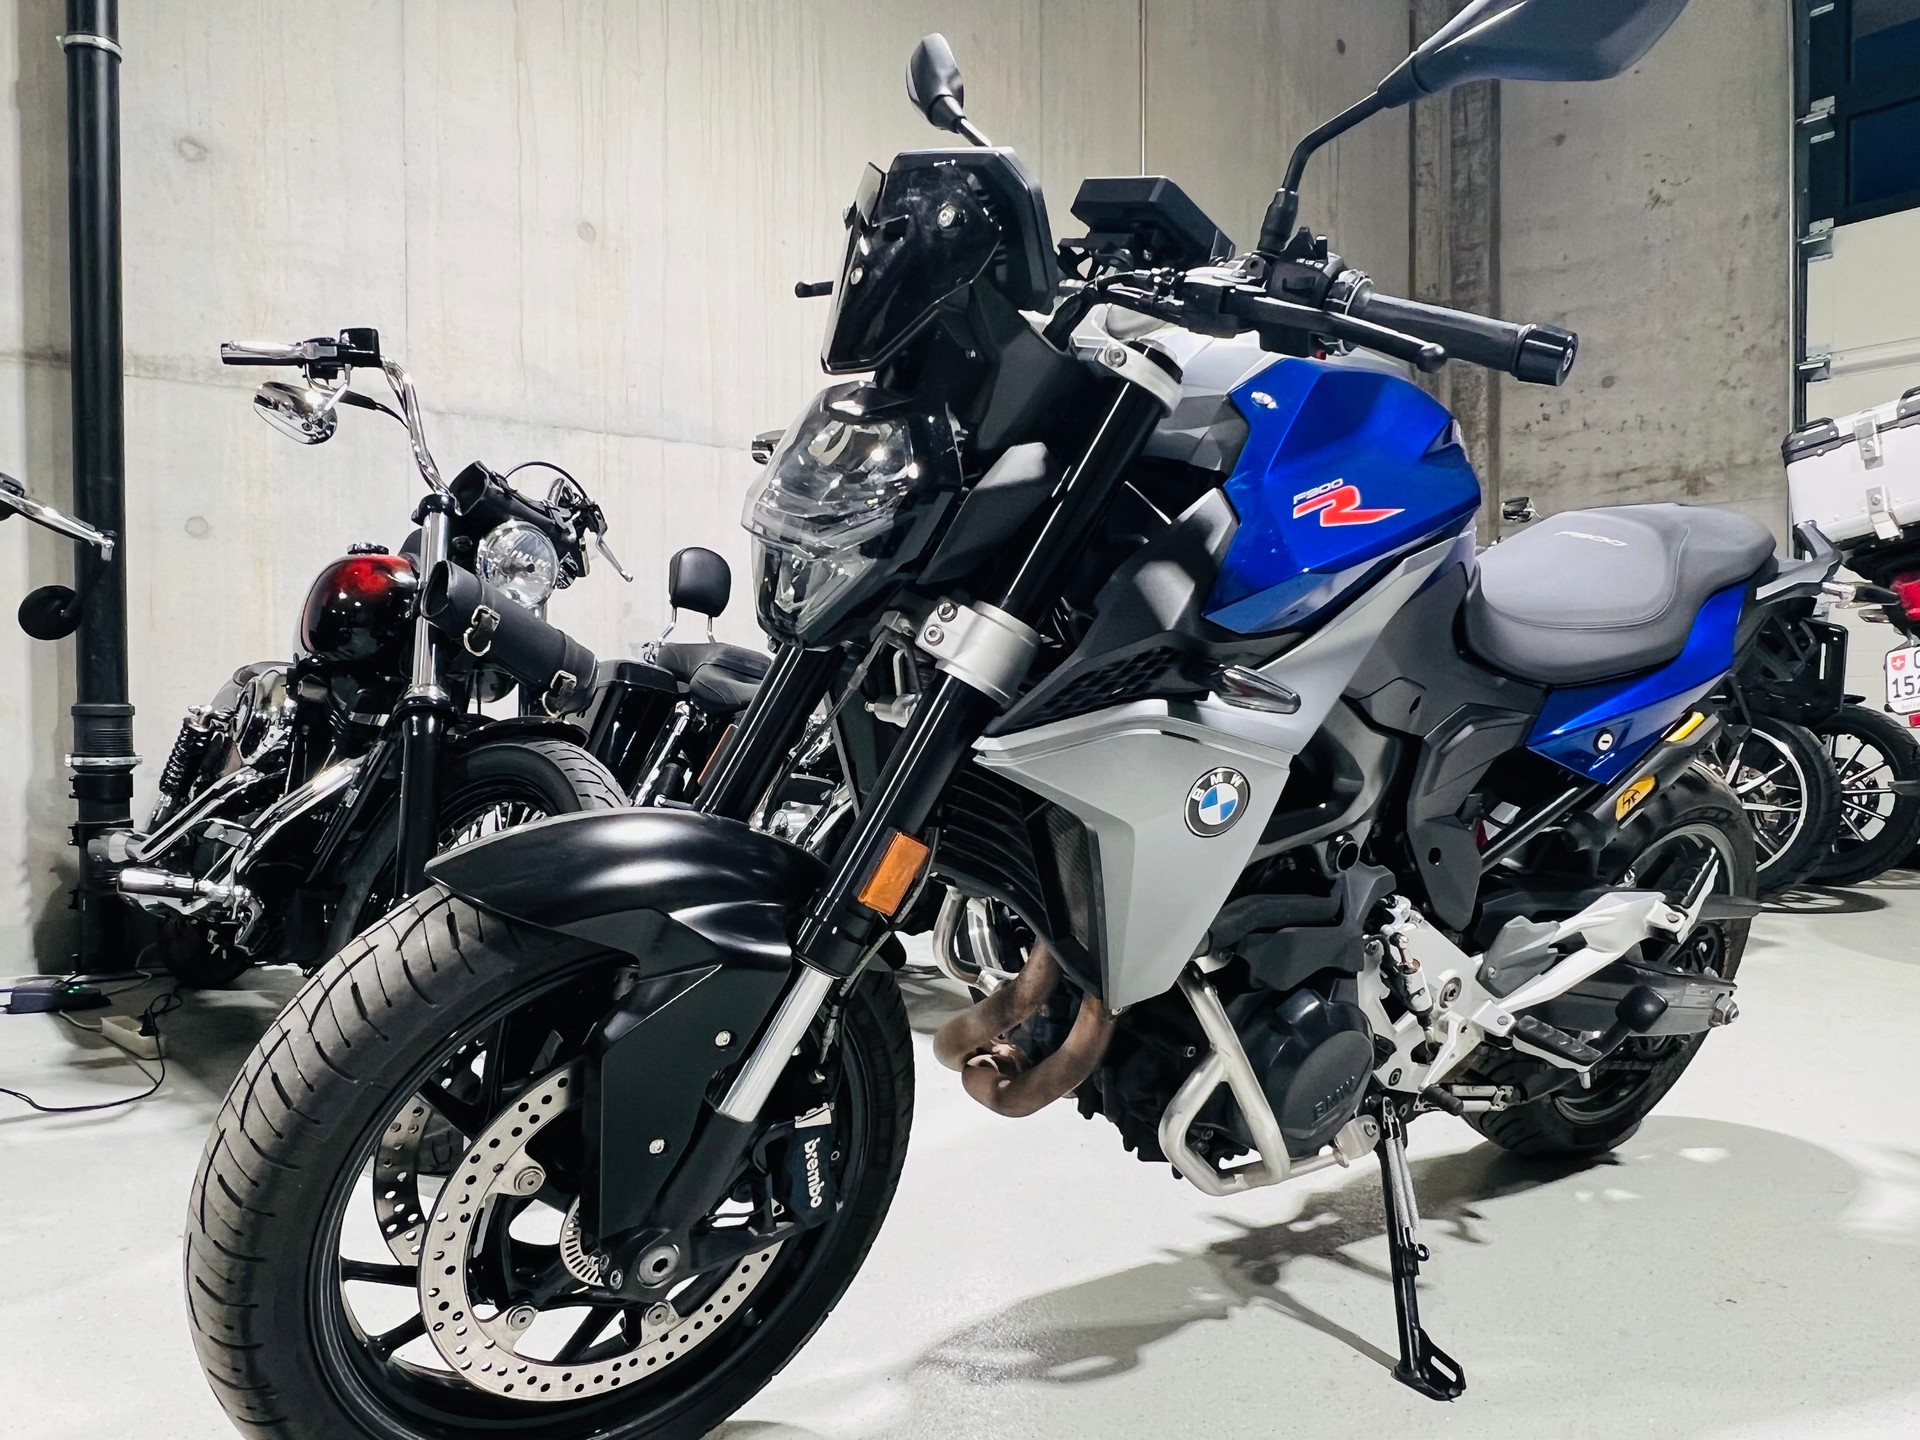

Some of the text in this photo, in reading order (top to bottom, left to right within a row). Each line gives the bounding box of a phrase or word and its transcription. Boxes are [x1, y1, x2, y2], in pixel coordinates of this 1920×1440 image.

[1892, 675, 1920, 699] 15
[1191, 773, 1244, 802] BMW
[804, 1137, 825, 1208] brembo
